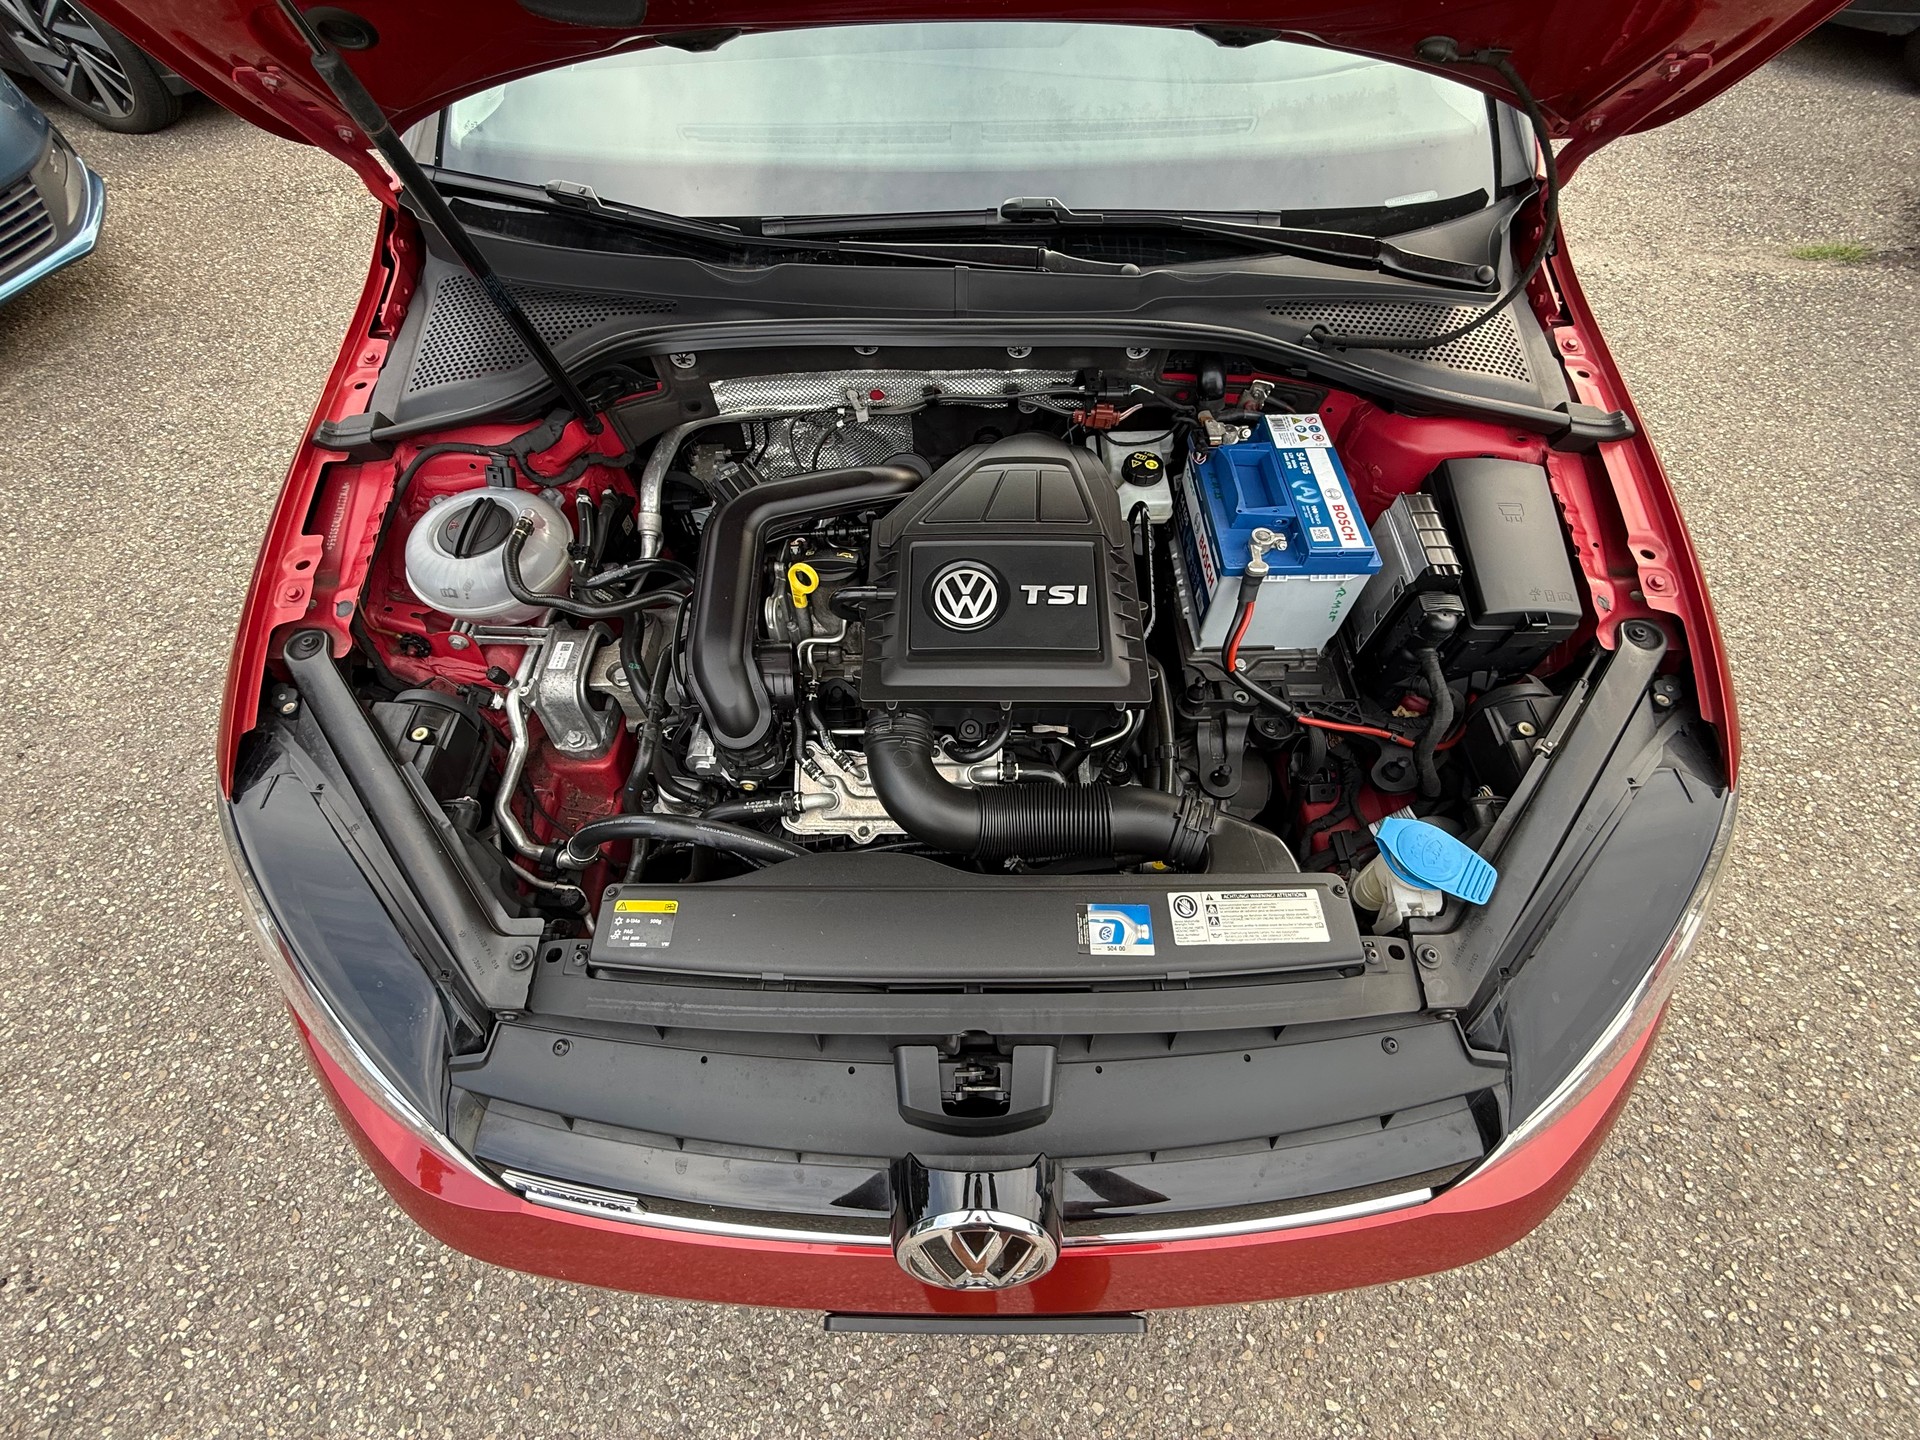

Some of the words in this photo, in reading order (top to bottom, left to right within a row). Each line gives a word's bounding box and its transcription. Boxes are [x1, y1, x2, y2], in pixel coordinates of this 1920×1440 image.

[1295, 452, 1307, 461] S4
[1331, 504, 1357, 541] BOSCH
[1199, 533, 1215, 590] BOSCH
[1020, 584, 1089, 606] TSI
